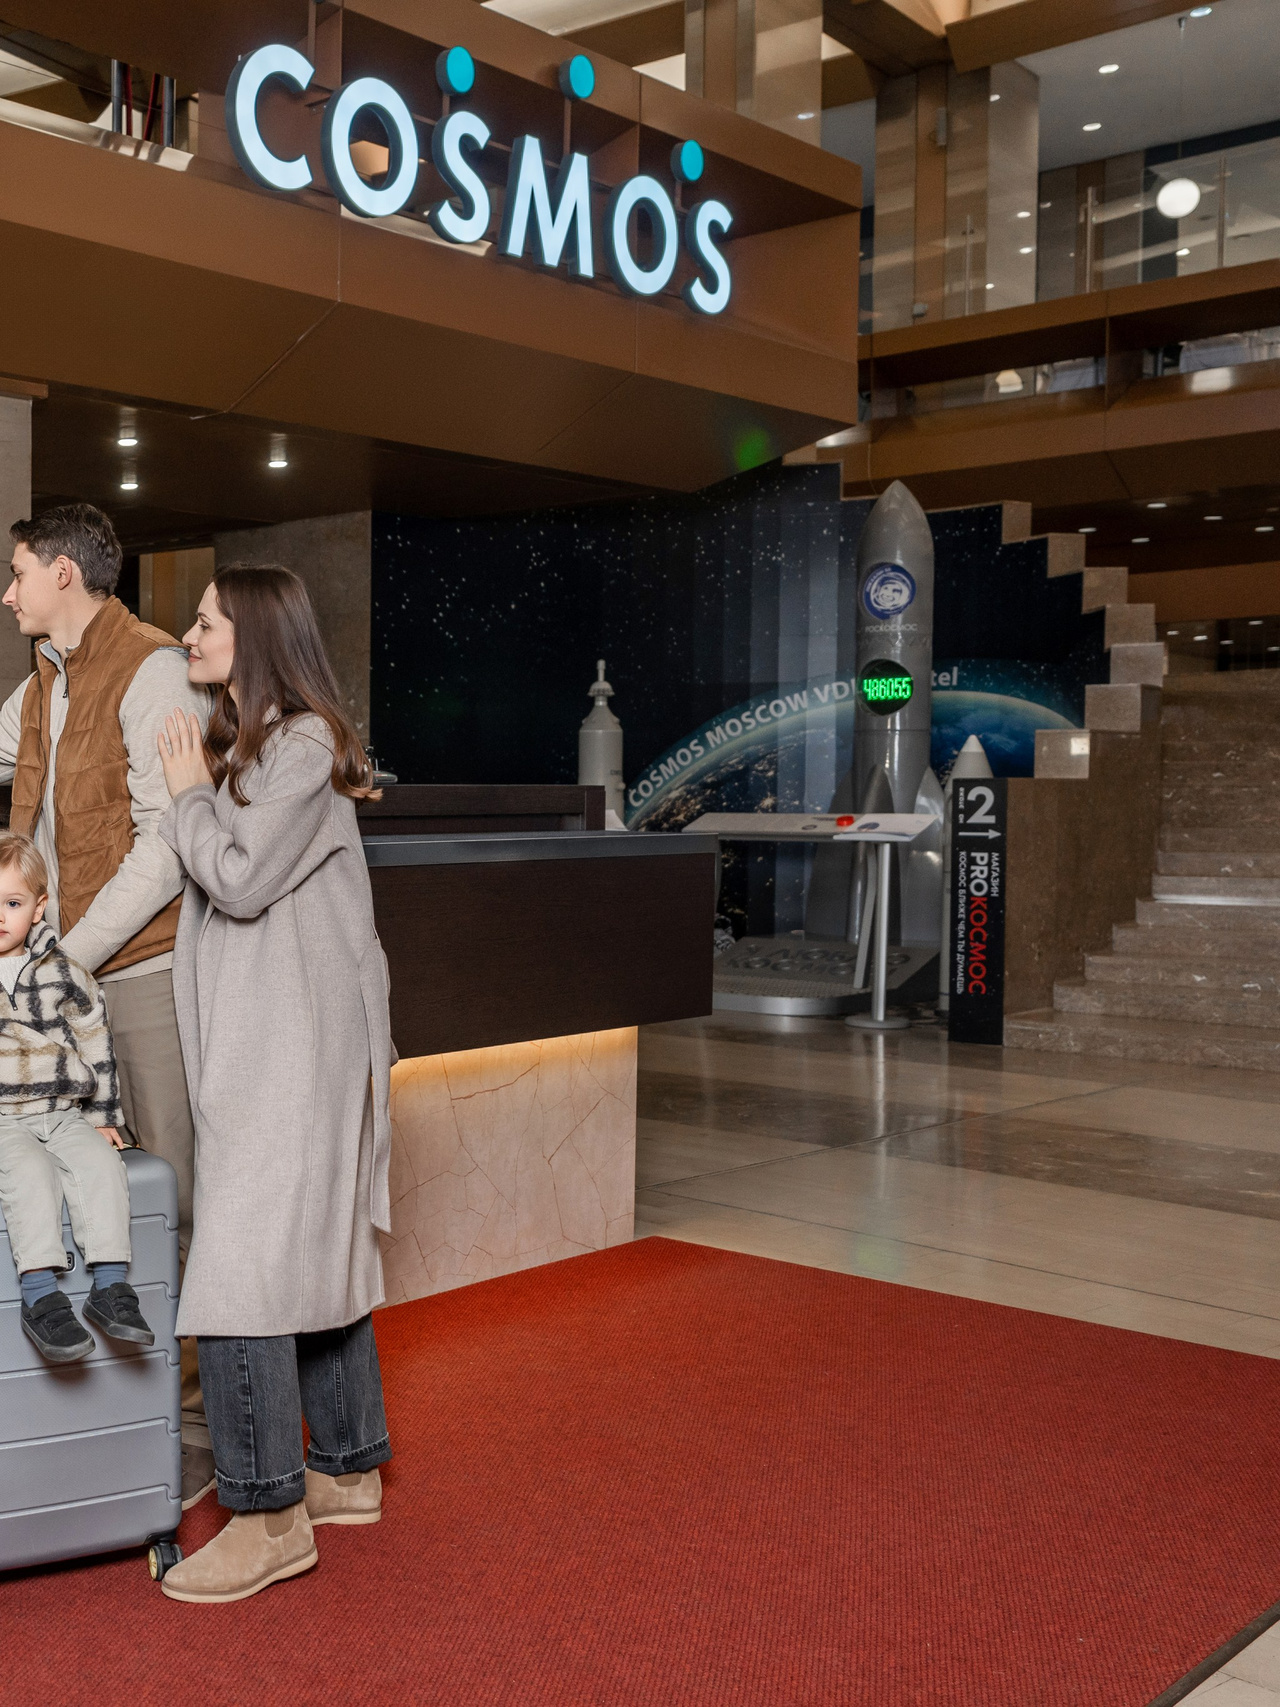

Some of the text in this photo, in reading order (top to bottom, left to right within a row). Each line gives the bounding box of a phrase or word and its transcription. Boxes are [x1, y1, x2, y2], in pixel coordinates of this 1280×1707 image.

[225, 43, 735, 315] COSMOS
[863, 676, 912, 701] 486055
[628, 740, 705, 808] COSMOS
[705, 690, 808, 751] MOSCOW
[931, 667, 959, 687] tel
[966, 785, 996, 824] 2
[990, 852, 999, 897] МАГАЗИН
[956, 851, 967, 995] КОСМОС БЛИЖЕ ЧЕМ ТЫ ДУМАЕШЬ
